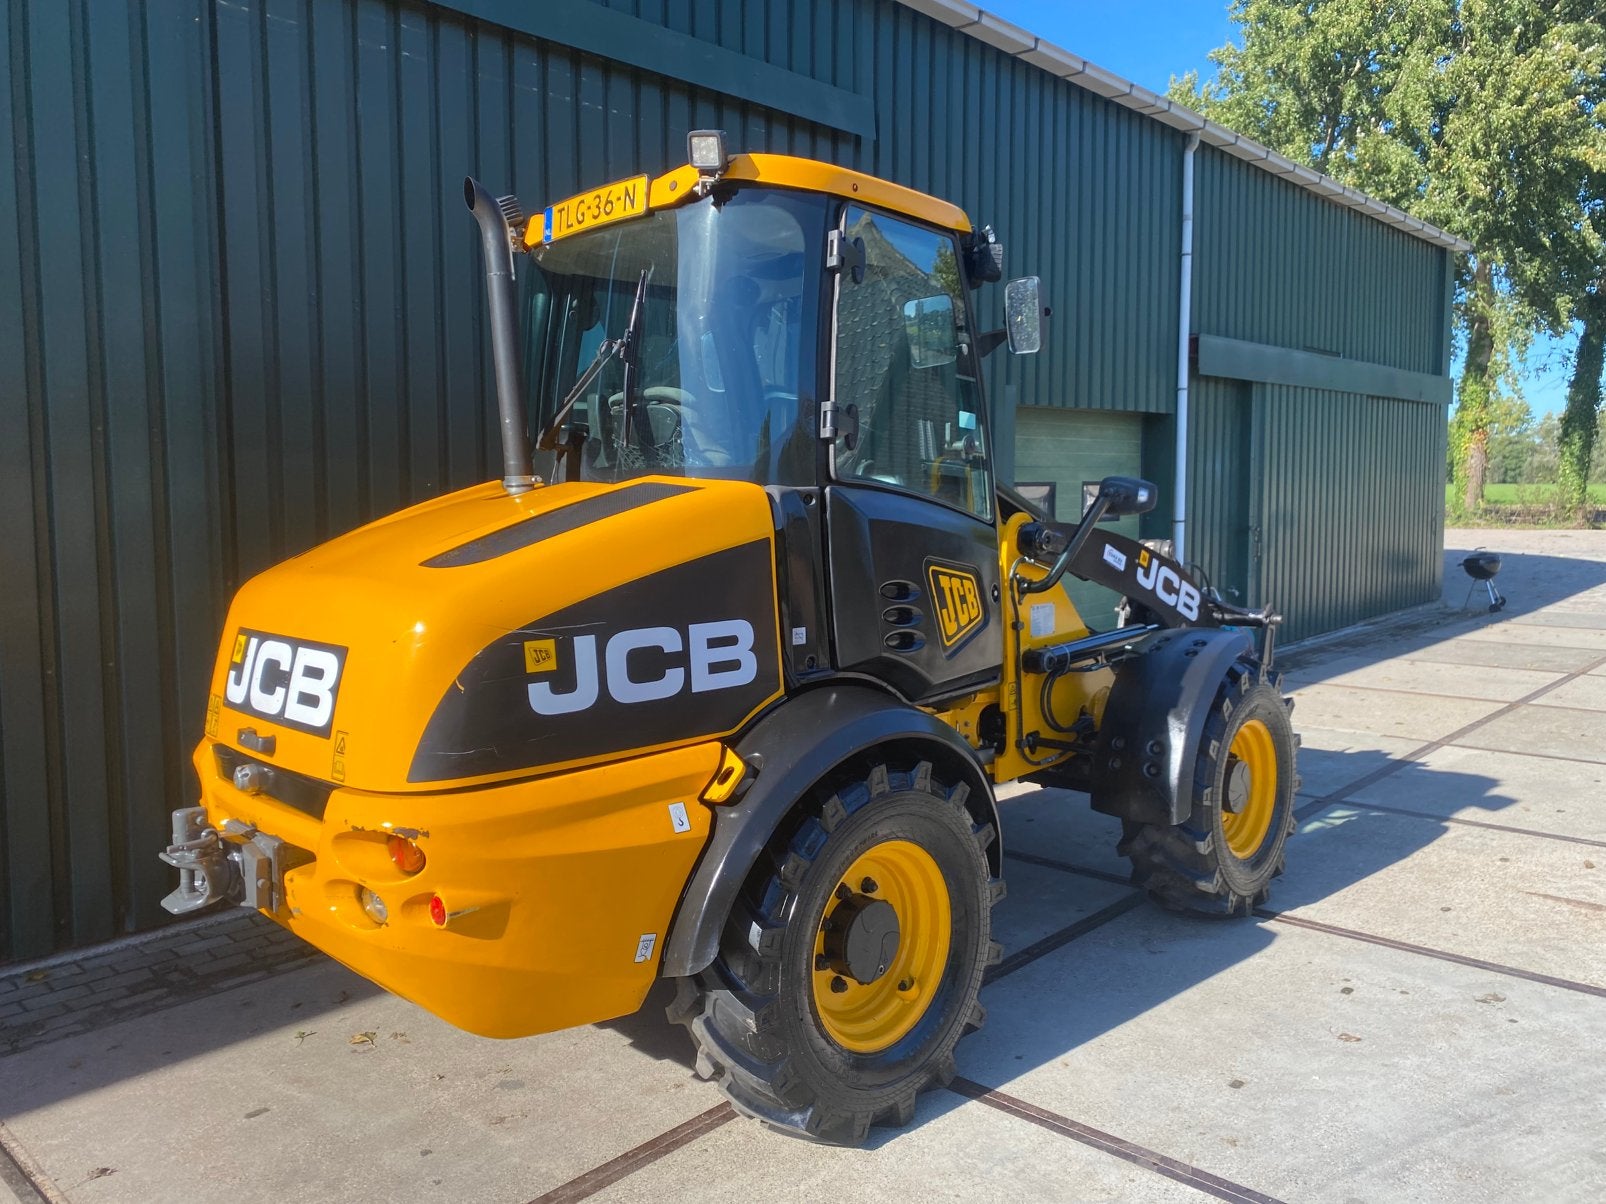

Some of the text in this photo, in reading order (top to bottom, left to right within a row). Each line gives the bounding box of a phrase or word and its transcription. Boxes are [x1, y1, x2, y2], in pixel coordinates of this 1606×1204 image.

[558, 184, 635, 232] TLG-36-N
[939, 575, 979, 636] JCB
[1137, 558, 1200, 622] JCB
[226, 637, 339, 727] JCB
[528, 619, 757, 715] JCB
